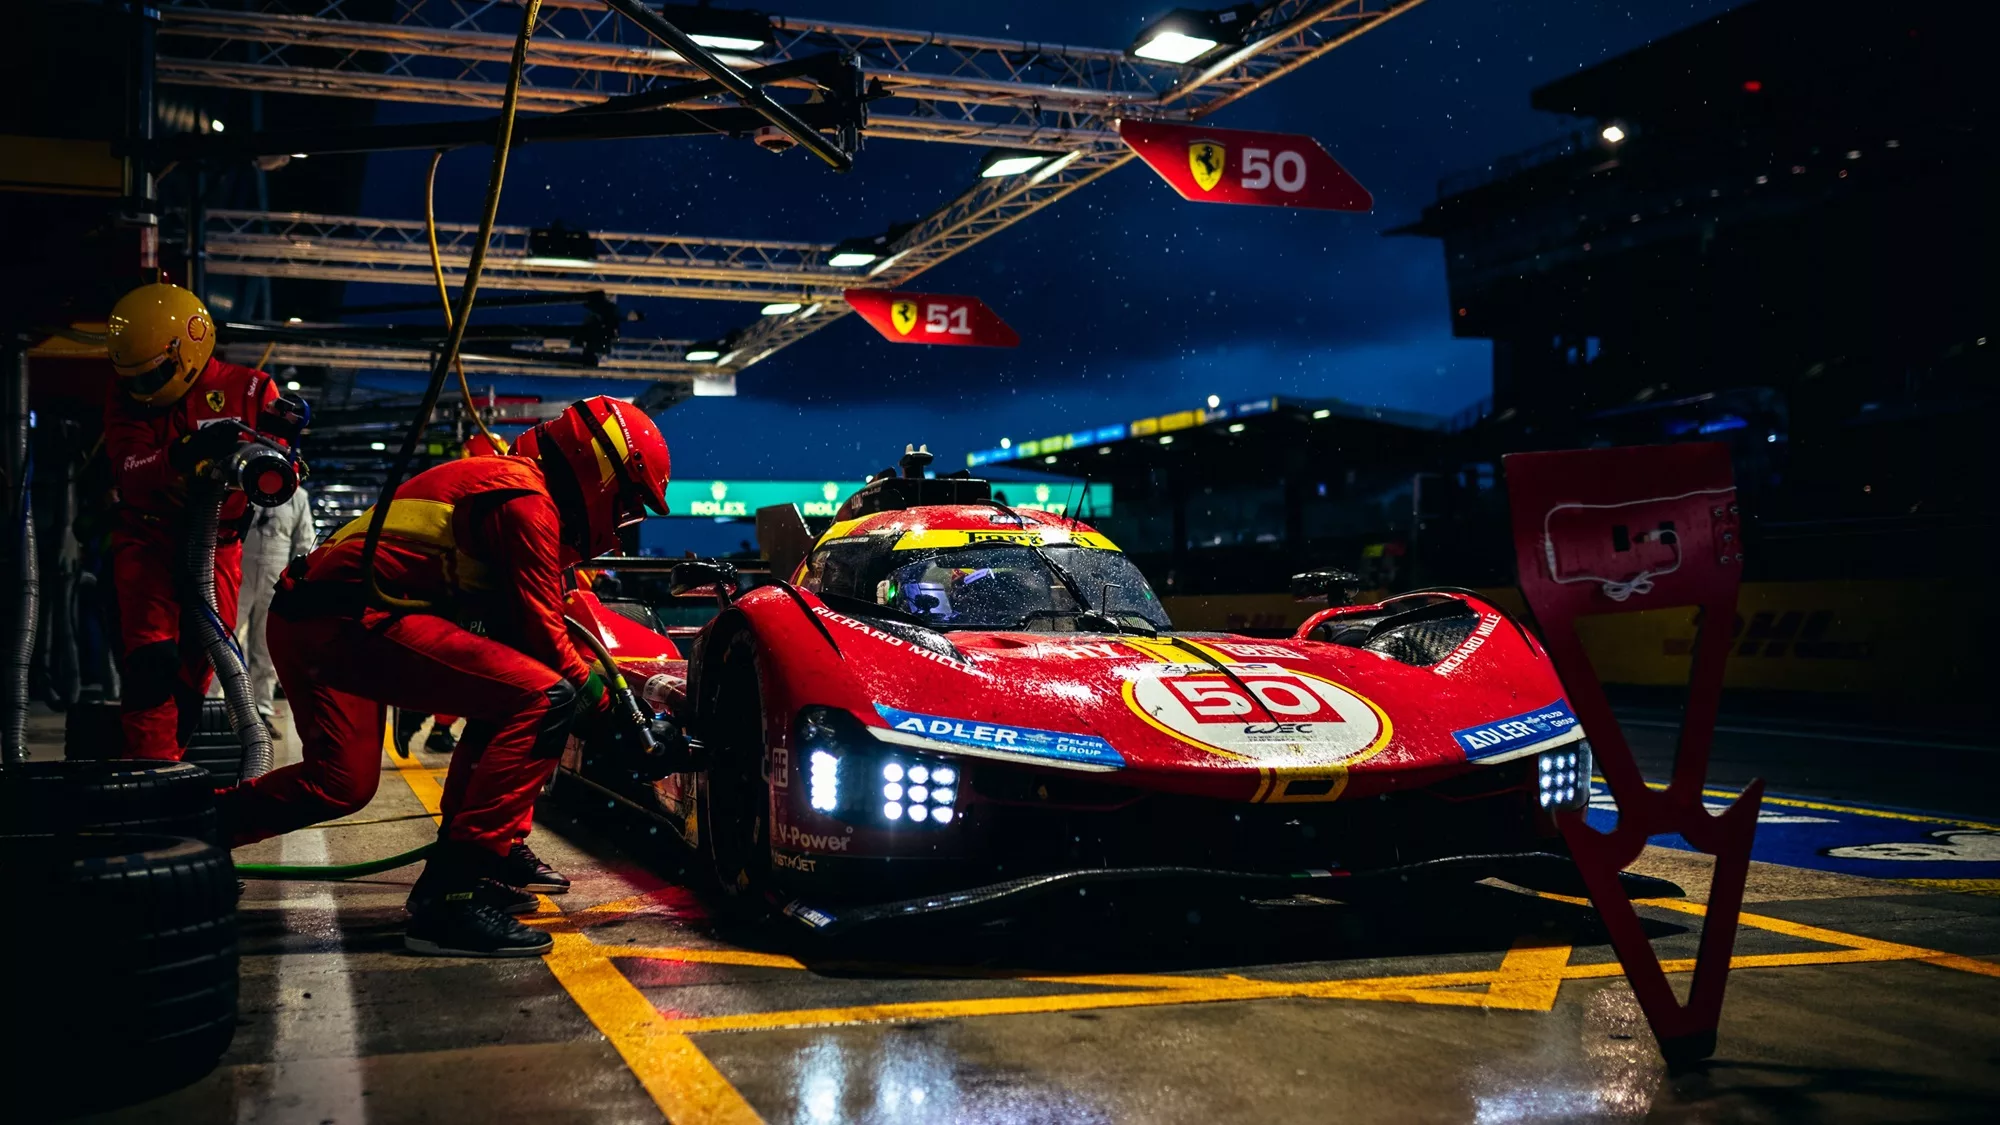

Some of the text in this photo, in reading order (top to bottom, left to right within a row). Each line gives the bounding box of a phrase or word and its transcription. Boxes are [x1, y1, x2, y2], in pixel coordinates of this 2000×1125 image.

[1241, 147, 1307, 192] 50
[925, 303, 972, 335] 51
[691, 501, 747, 515] ROLEX
[804, 502, 844, 515] ROL
[812, 606, 980, 676] RICHARD MILLE
[1434, 612, 1502, 677] RICHARD MILLE
[1171, 680, 1322, 716] 50
[894, 716, 1018, 744] ADLER
[1056, 736, 1103, 749] PELZER
[1244, 722, 1313, 735] WEC
[1462, 720, 1538, 750] ADLER
[1056, 744, 1102, 757] GROUP
[778, 823, 851, 851] V-Power
